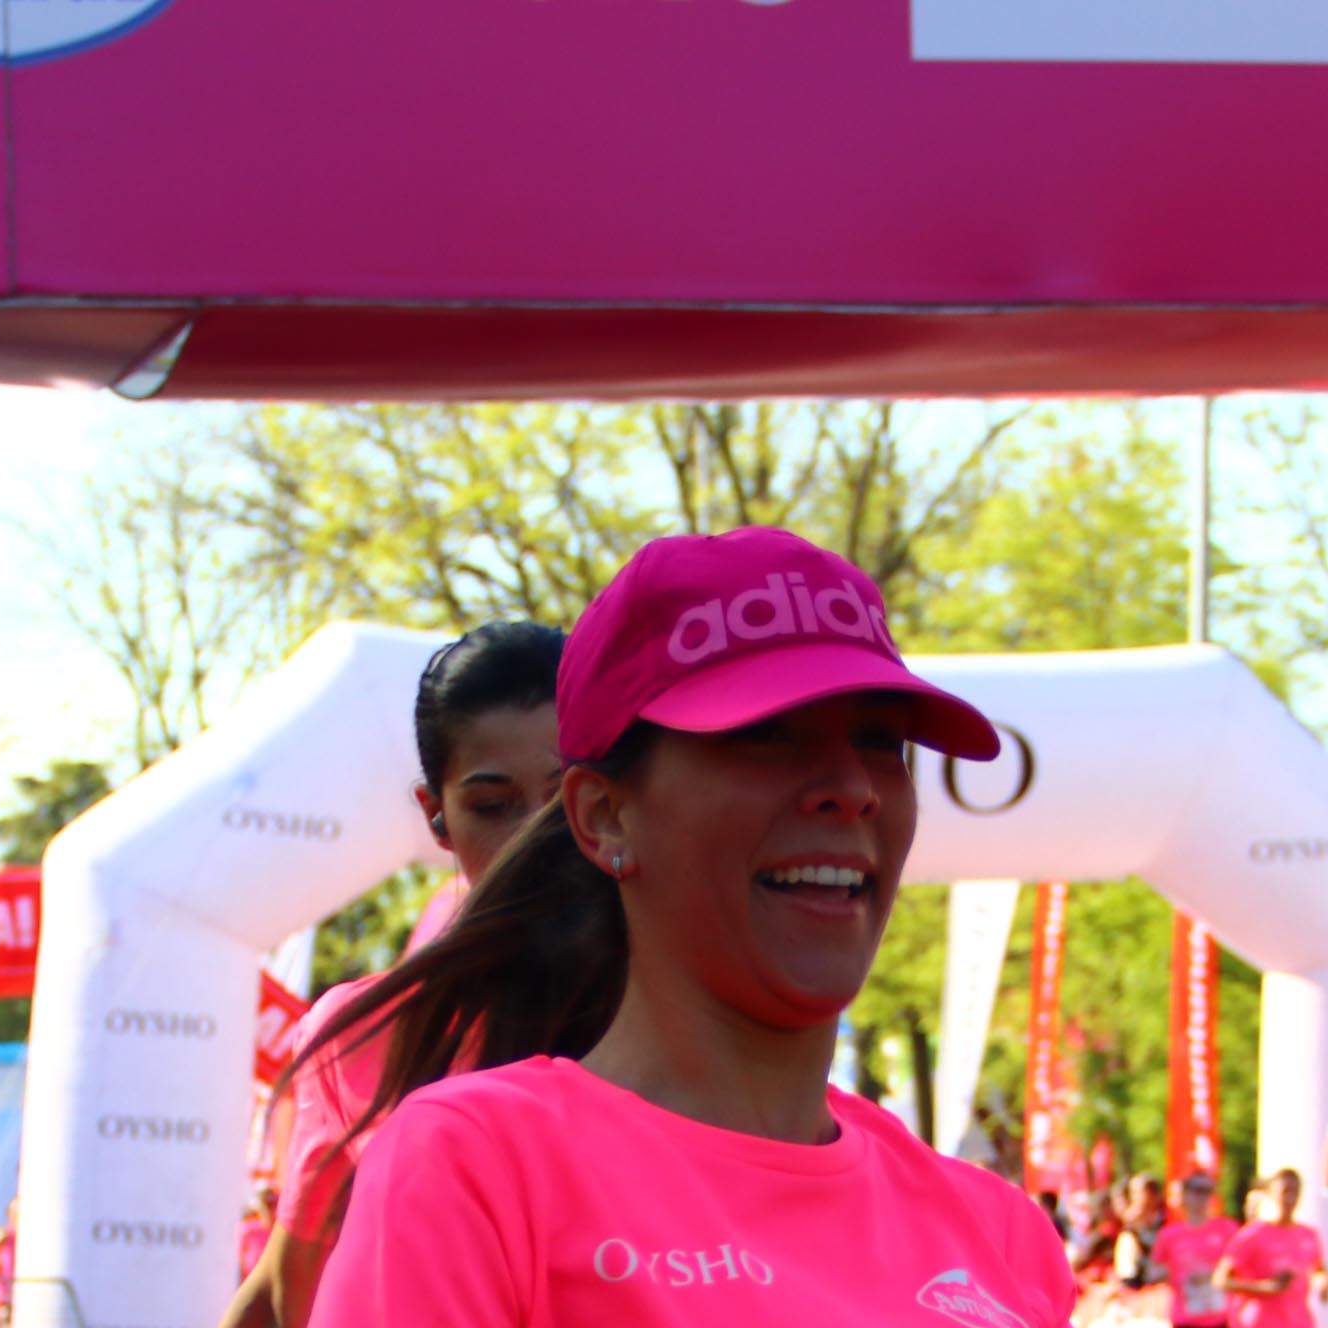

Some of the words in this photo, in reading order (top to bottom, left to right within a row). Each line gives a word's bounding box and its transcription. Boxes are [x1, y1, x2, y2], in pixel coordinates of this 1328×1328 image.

[222, 806, 342, 843] OYSHO
[105, 1007, 218, 1040] OYSHO
[97, 1113, 211, 1146] OYSHO
[91, 1219, 204, 1251] OYSHO
[593, 1238, 774, 1287] OYSHO
